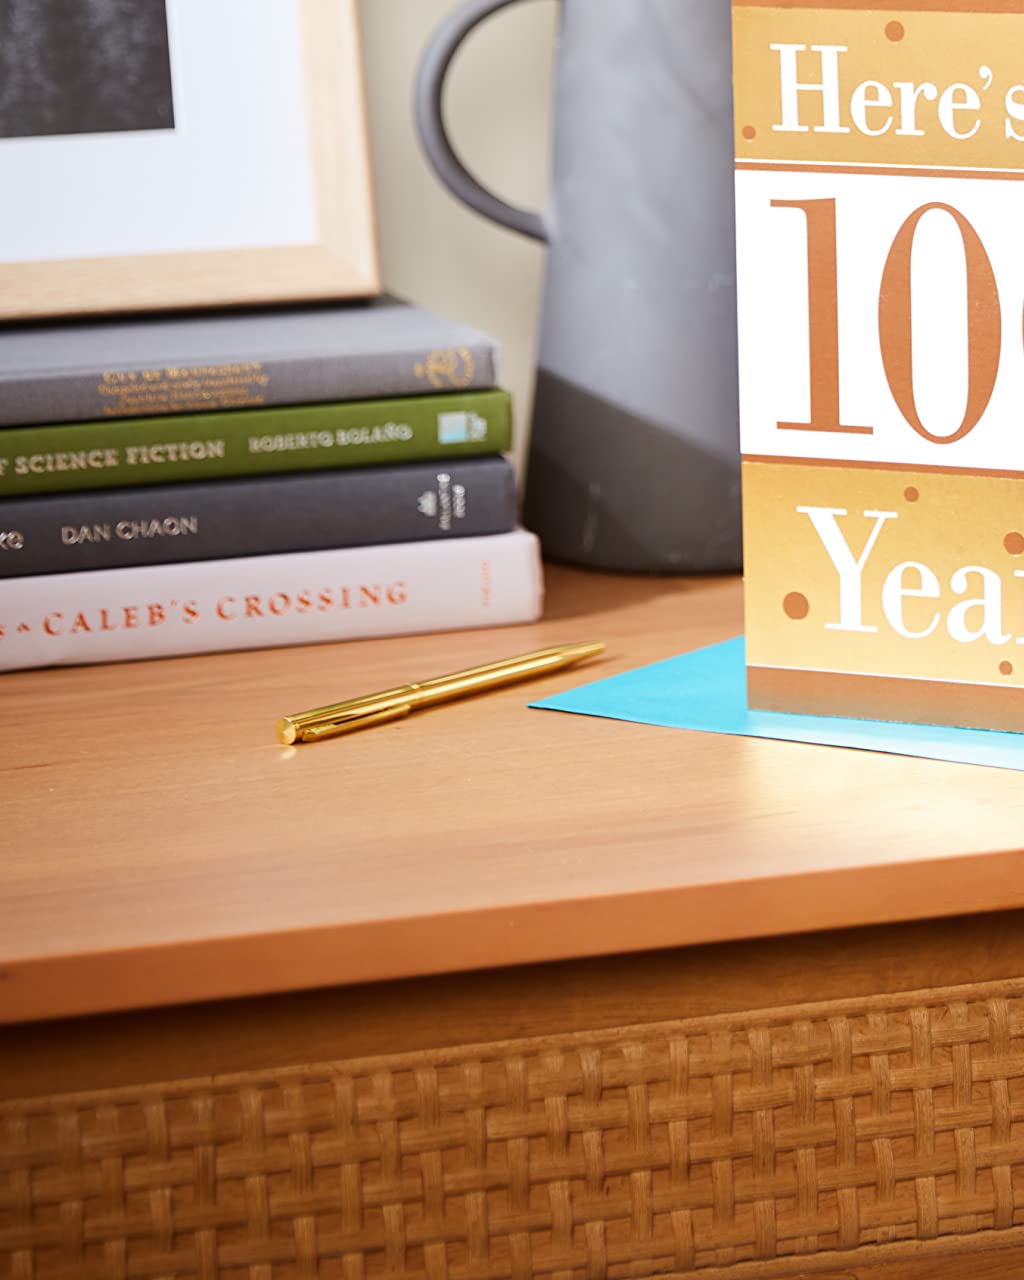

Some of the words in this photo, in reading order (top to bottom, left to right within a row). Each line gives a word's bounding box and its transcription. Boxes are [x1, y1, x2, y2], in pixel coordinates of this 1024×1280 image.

[248, 430, 334, 454] ROBERTO
[335, 422, 414, 446] BOLAÑO
[14, 448, 120, 475] SCIENCE
[125, 439, 226, 465] FICTION
[61, 524, 111, 545] DAN
[115, 516, 199, 540] CHAON
[42, 600, 200, 637] CALEB'S
[215, 581, 409, 621] CROSSING
